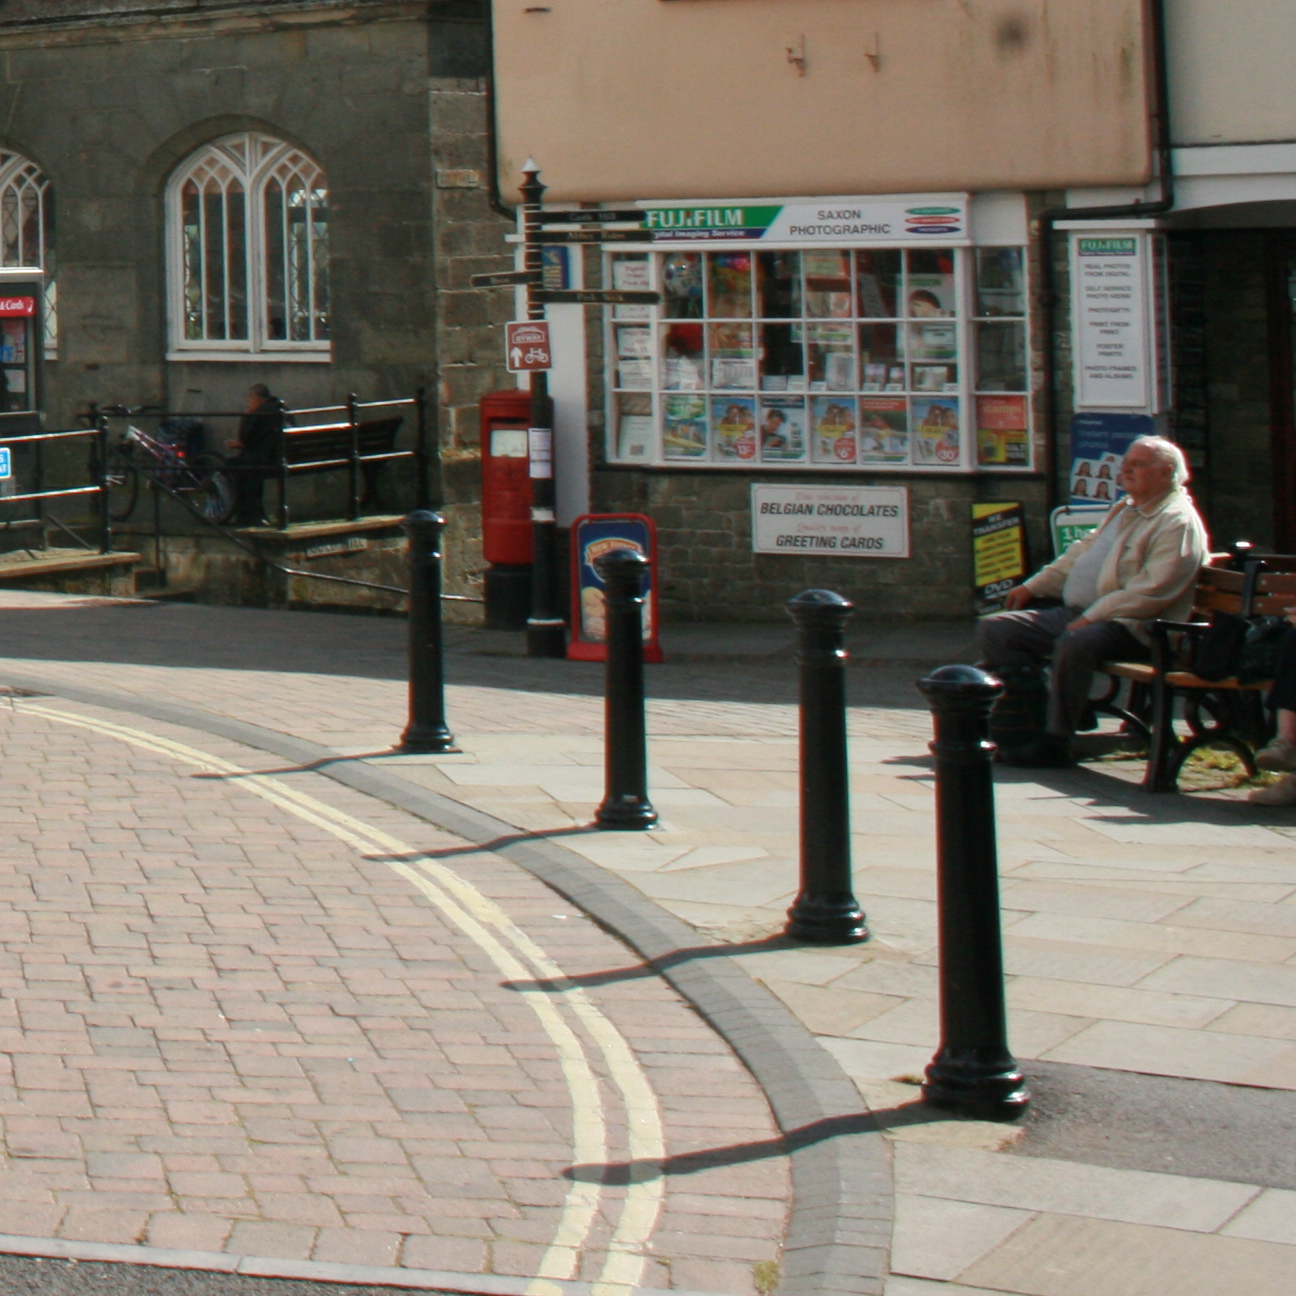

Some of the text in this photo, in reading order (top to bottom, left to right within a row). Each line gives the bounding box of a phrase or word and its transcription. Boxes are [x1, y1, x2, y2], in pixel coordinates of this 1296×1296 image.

[817, 209, 861, 221] SAXON
[789, 223, 891, 236] PHOTOGRAPHIC
[5, 299, 24, 311] Cards
[760, 502, 899, 517] BELGIAN CHOCOLATES
[973, 517, 1020, 535] TRANSFER
[776, 534, 883, 549] GREETING CARDS
